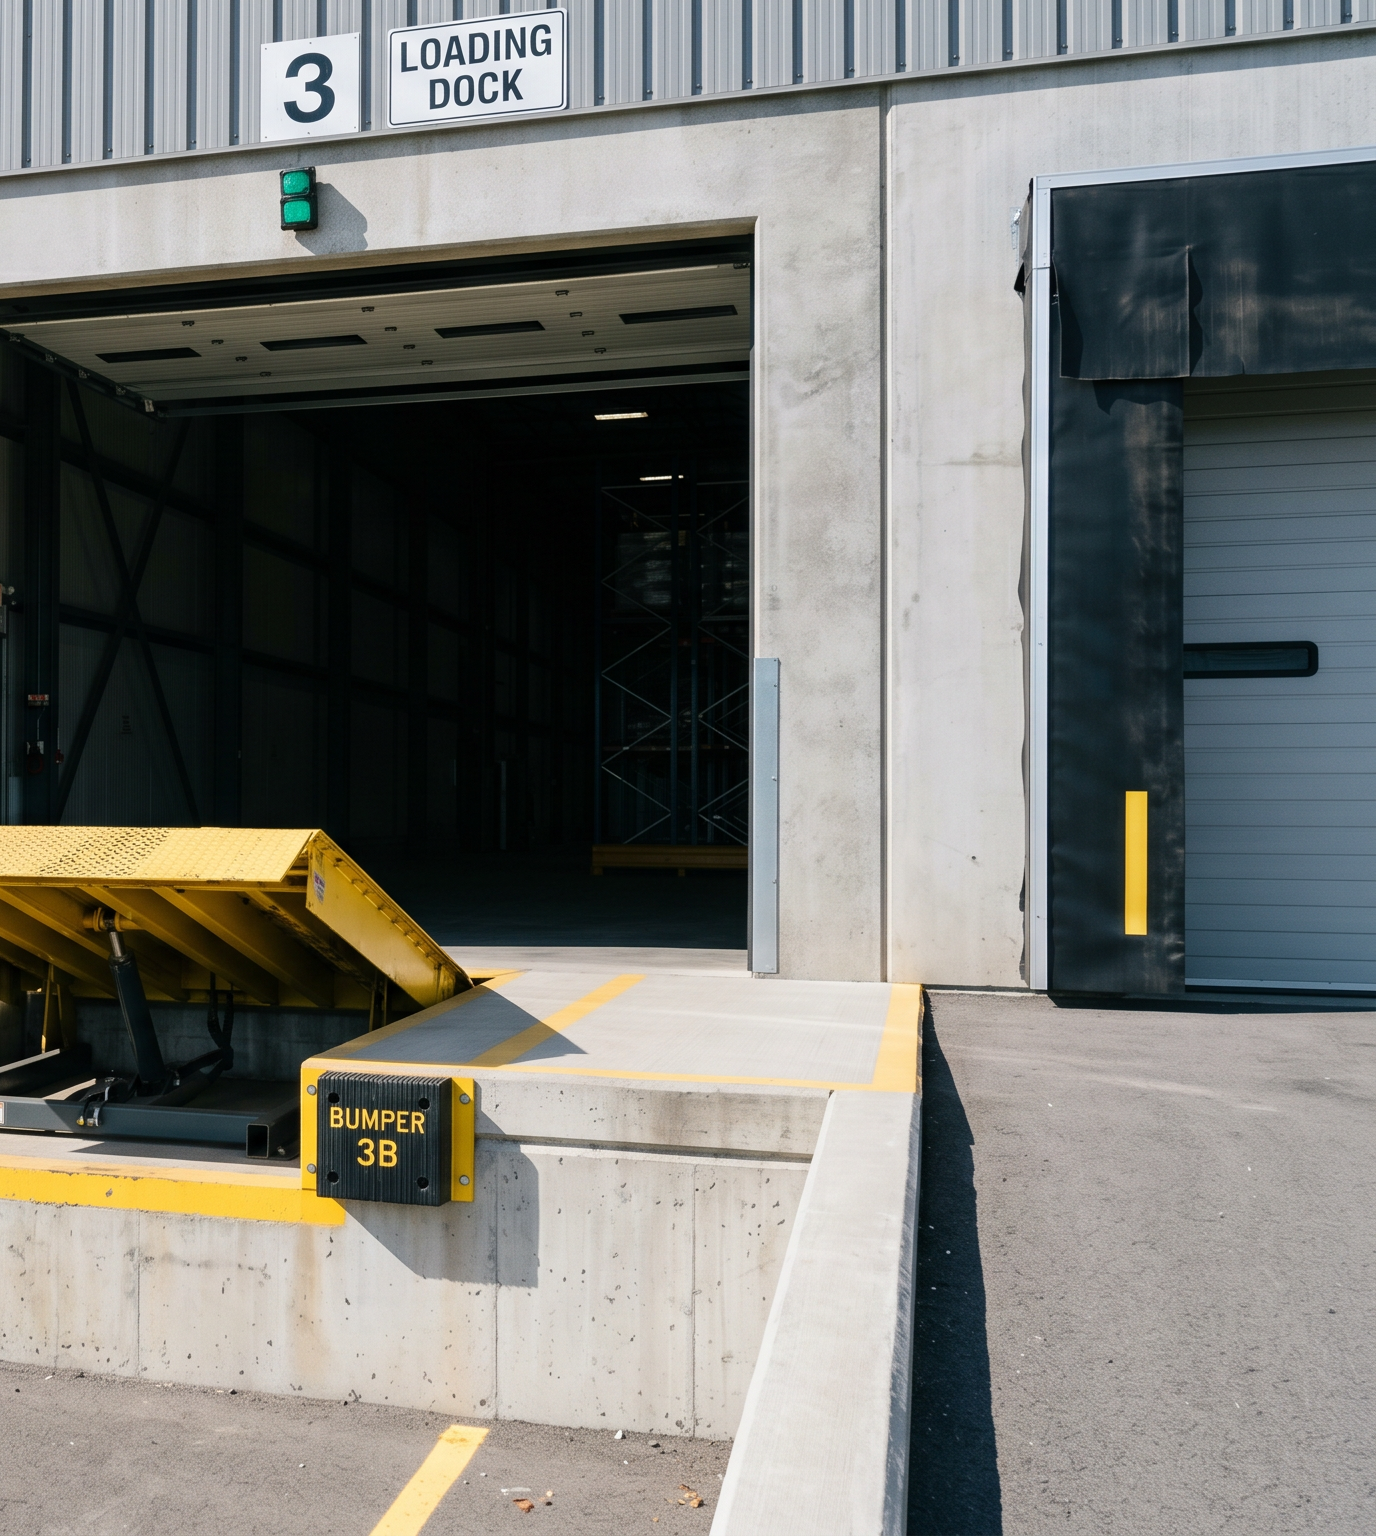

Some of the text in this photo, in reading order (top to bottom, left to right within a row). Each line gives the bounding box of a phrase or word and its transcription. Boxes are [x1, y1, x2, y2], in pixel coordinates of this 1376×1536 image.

[400, 23, 552, 73] LOADING
[283, 52, 336, 123] 3
[429, 68, 524, 110] DOCK
[330, 1106, 425, 1134] BUMPER
[357, 1138, 398, 1168] 3B
